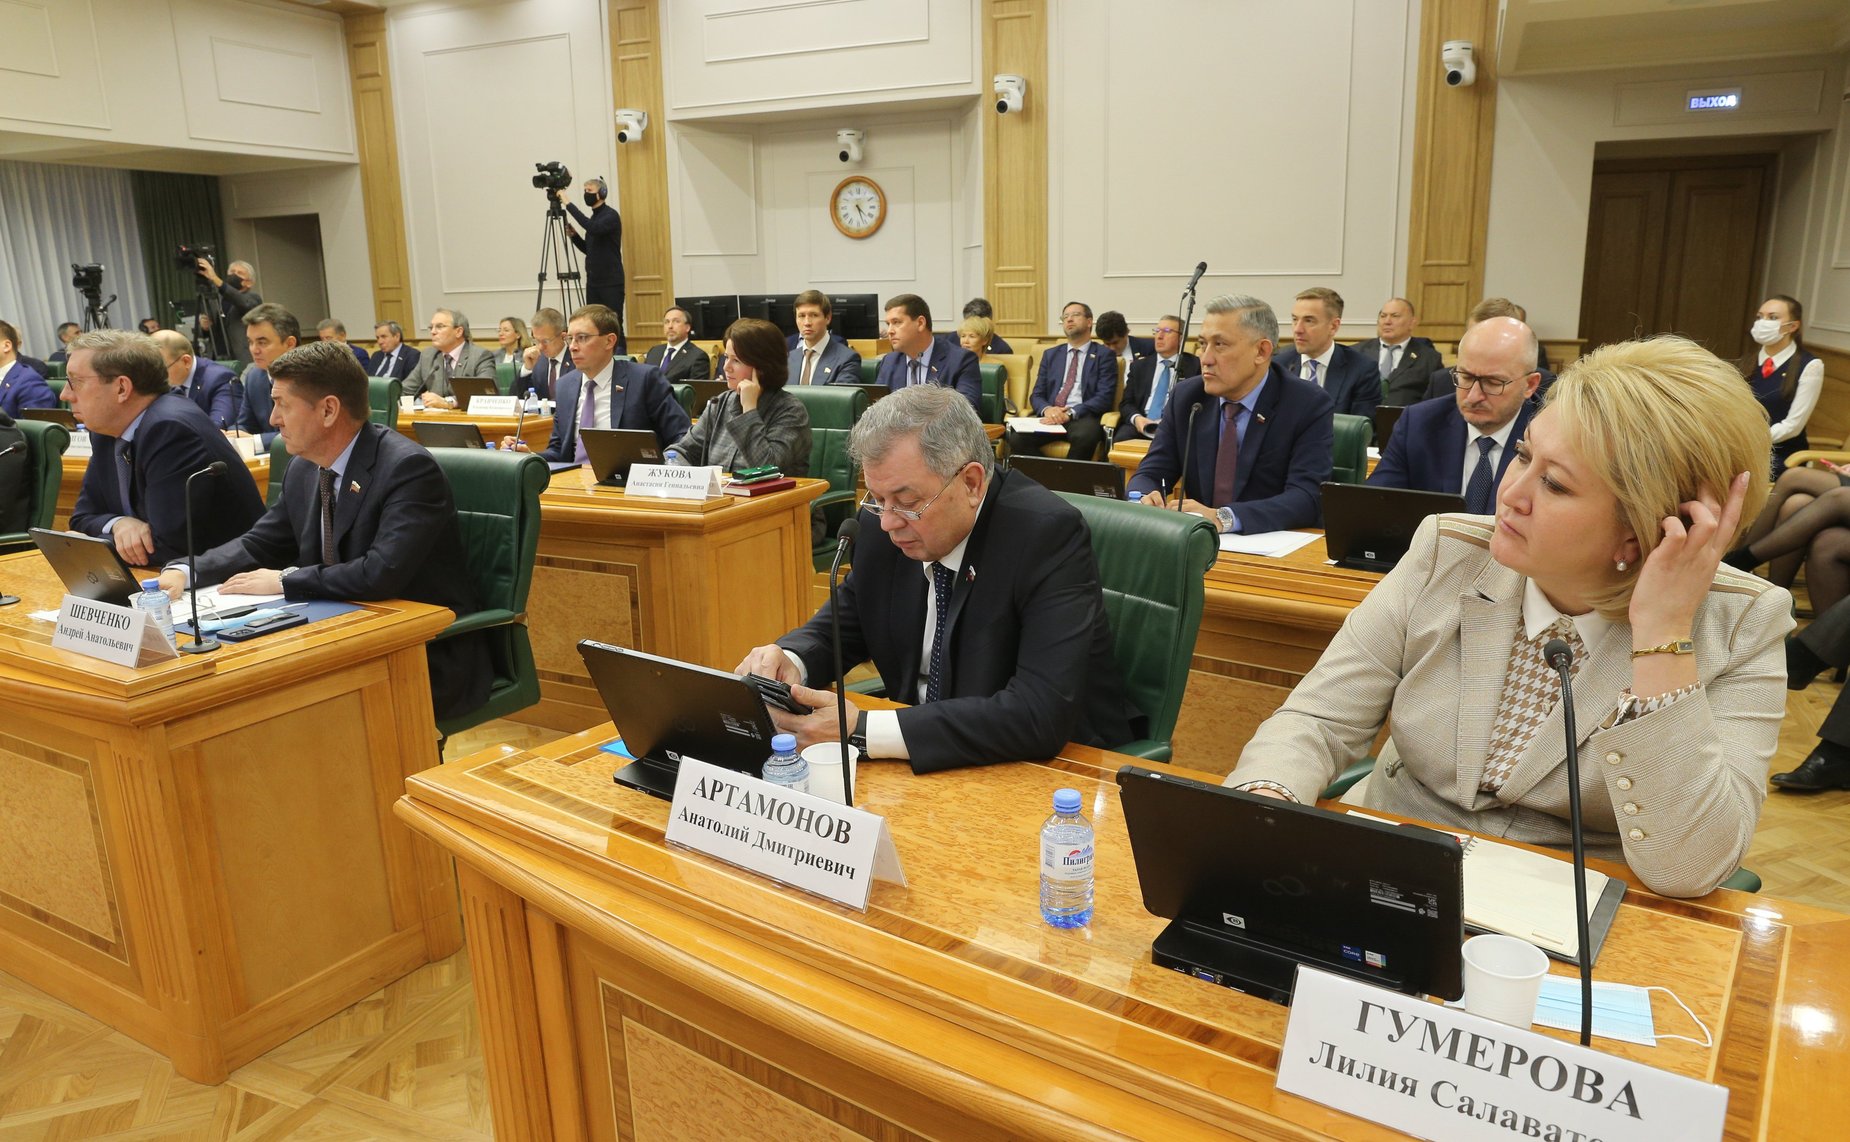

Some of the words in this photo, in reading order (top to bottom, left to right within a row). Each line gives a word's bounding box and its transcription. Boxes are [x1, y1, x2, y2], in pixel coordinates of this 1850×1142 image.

[1690, 95, 1737, 109] ВЫХОД
[631, 480, 663, 488] Анастасия
[648, 468, 692, 479] ЖУКОВА
[70, 603, 131, 631] ШЕВЧЕНКО
[58, 623, 84, 640] Андрей
[85, 630, 134, 652] Анатольевич
[693, 776, 852, 844] АРТАМОНОВ
[678, 806, 750, 843] Анатолий
[751, 830, 856, 880] Дмитриевич
[1354, 999, 1646, 1121] ГУМЕРОВА
[1309, 1040, 1420, 1098] Лилия
[1431, 1080, 1603, 1142] Салават
